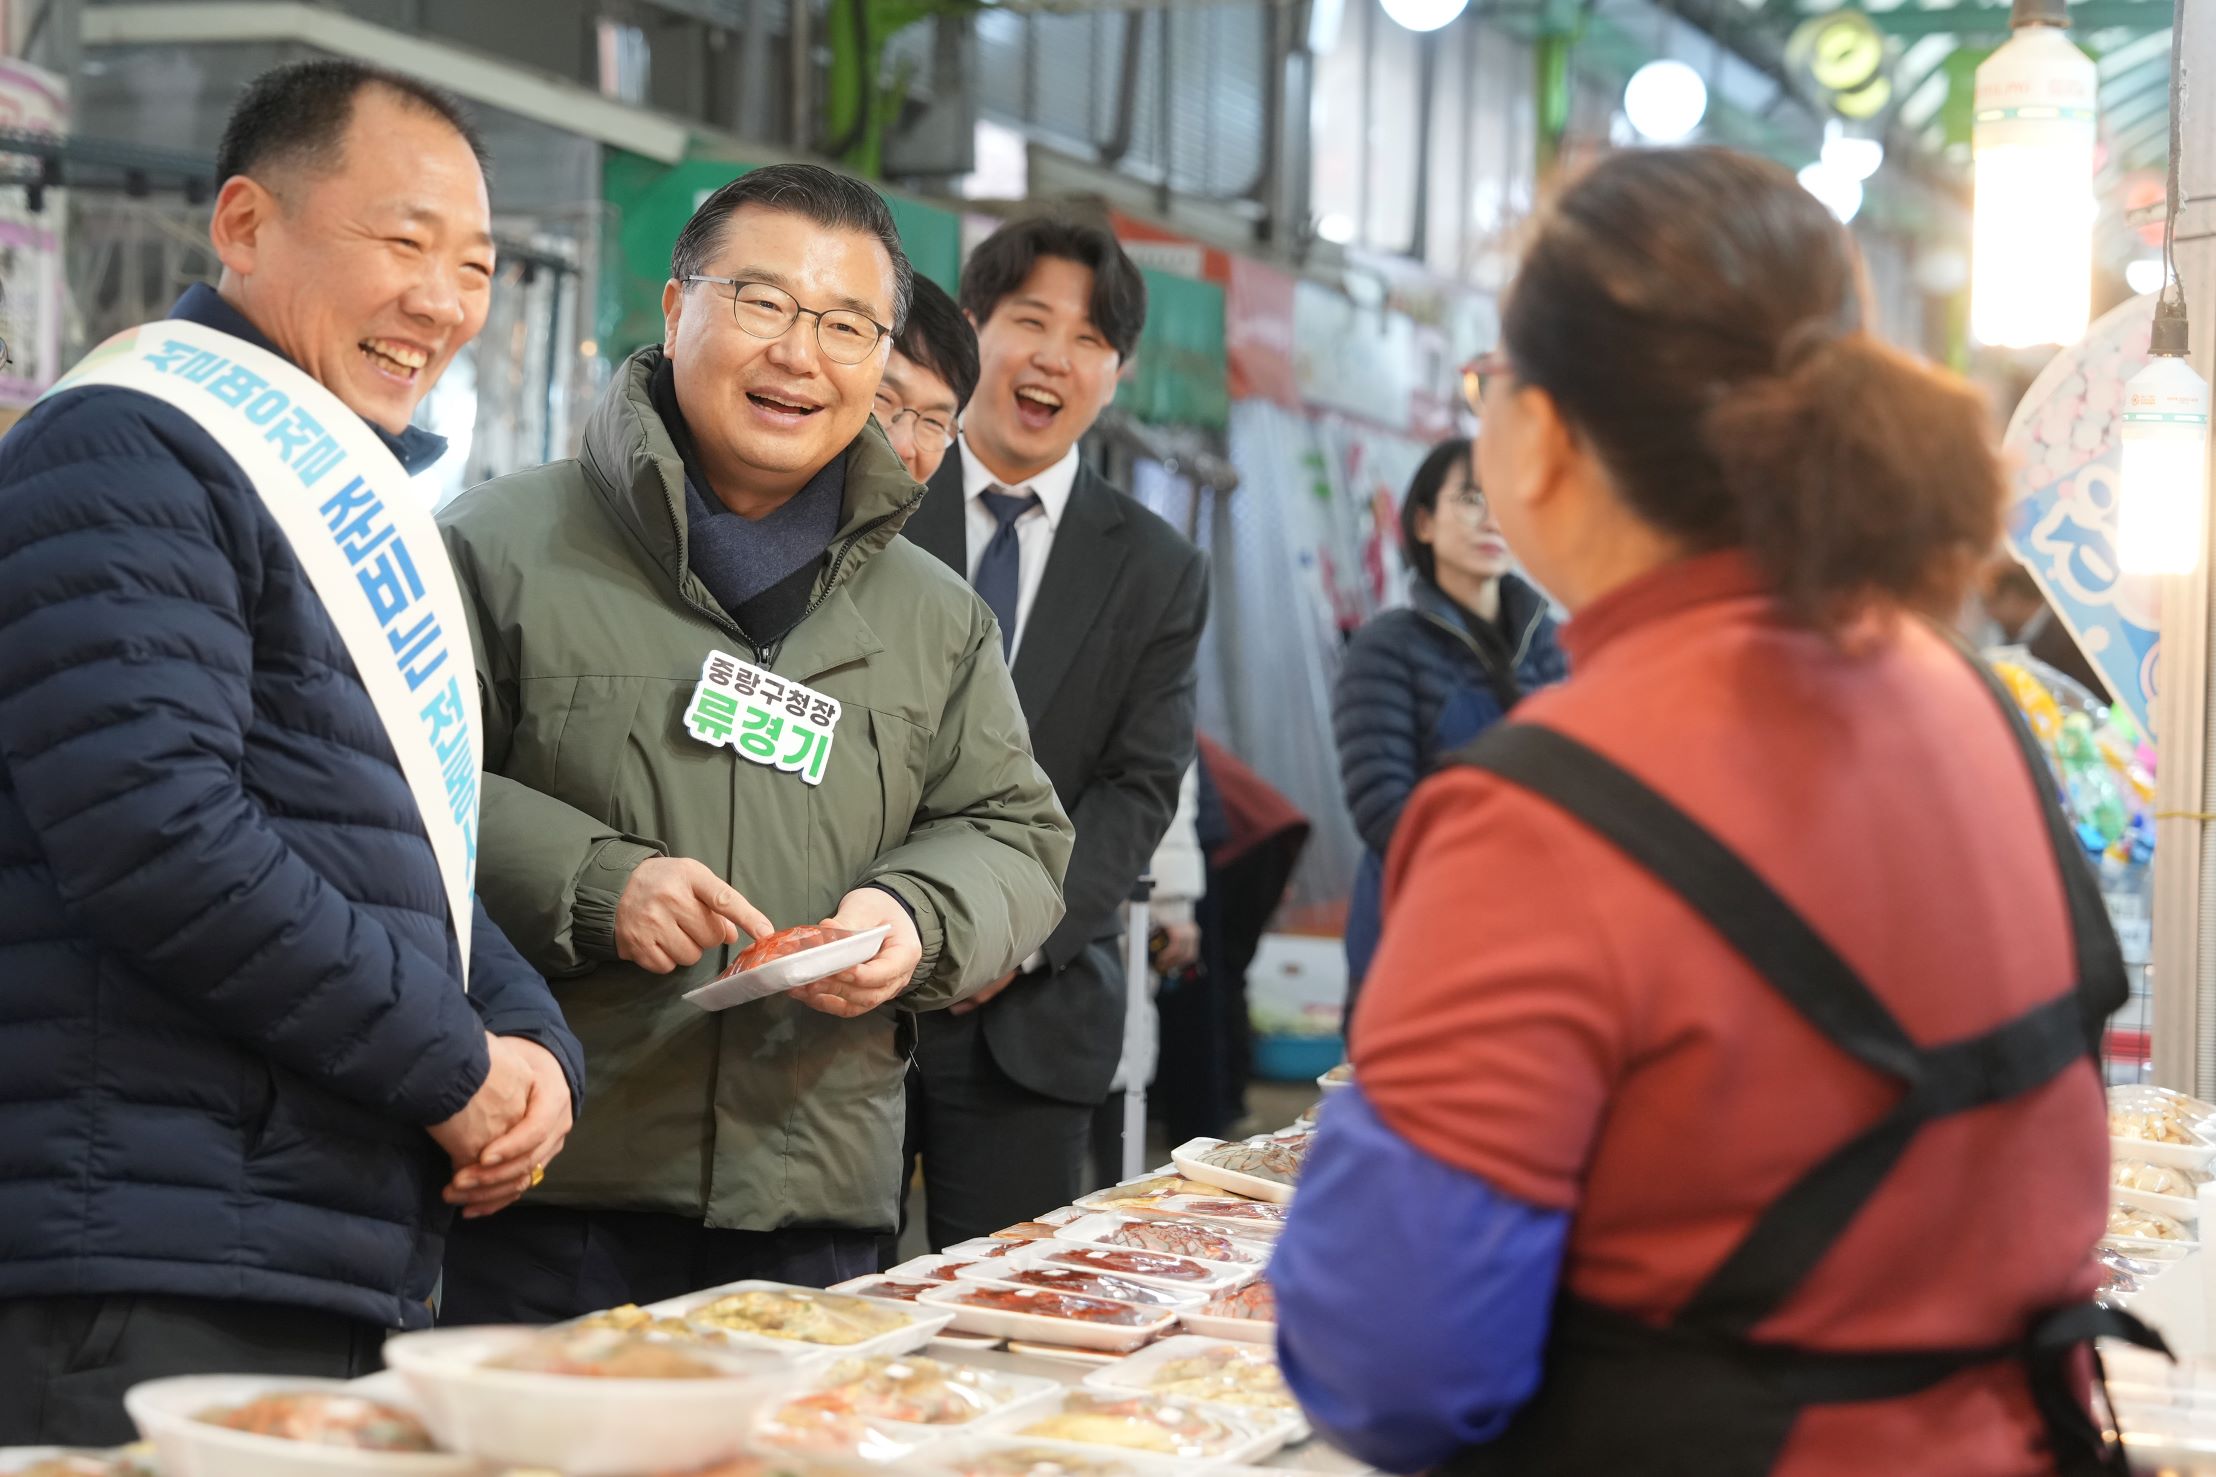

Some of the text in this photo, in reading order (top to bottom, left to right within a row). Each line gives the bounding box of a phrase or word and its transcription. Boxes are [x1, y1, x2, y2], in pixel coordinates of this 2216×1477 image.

[142, 339, 479, 903] 설명절 준비는 전통시
[690, 688, 829, 778] 류경기
[708, 656, 836, 728] 중랑구청장
